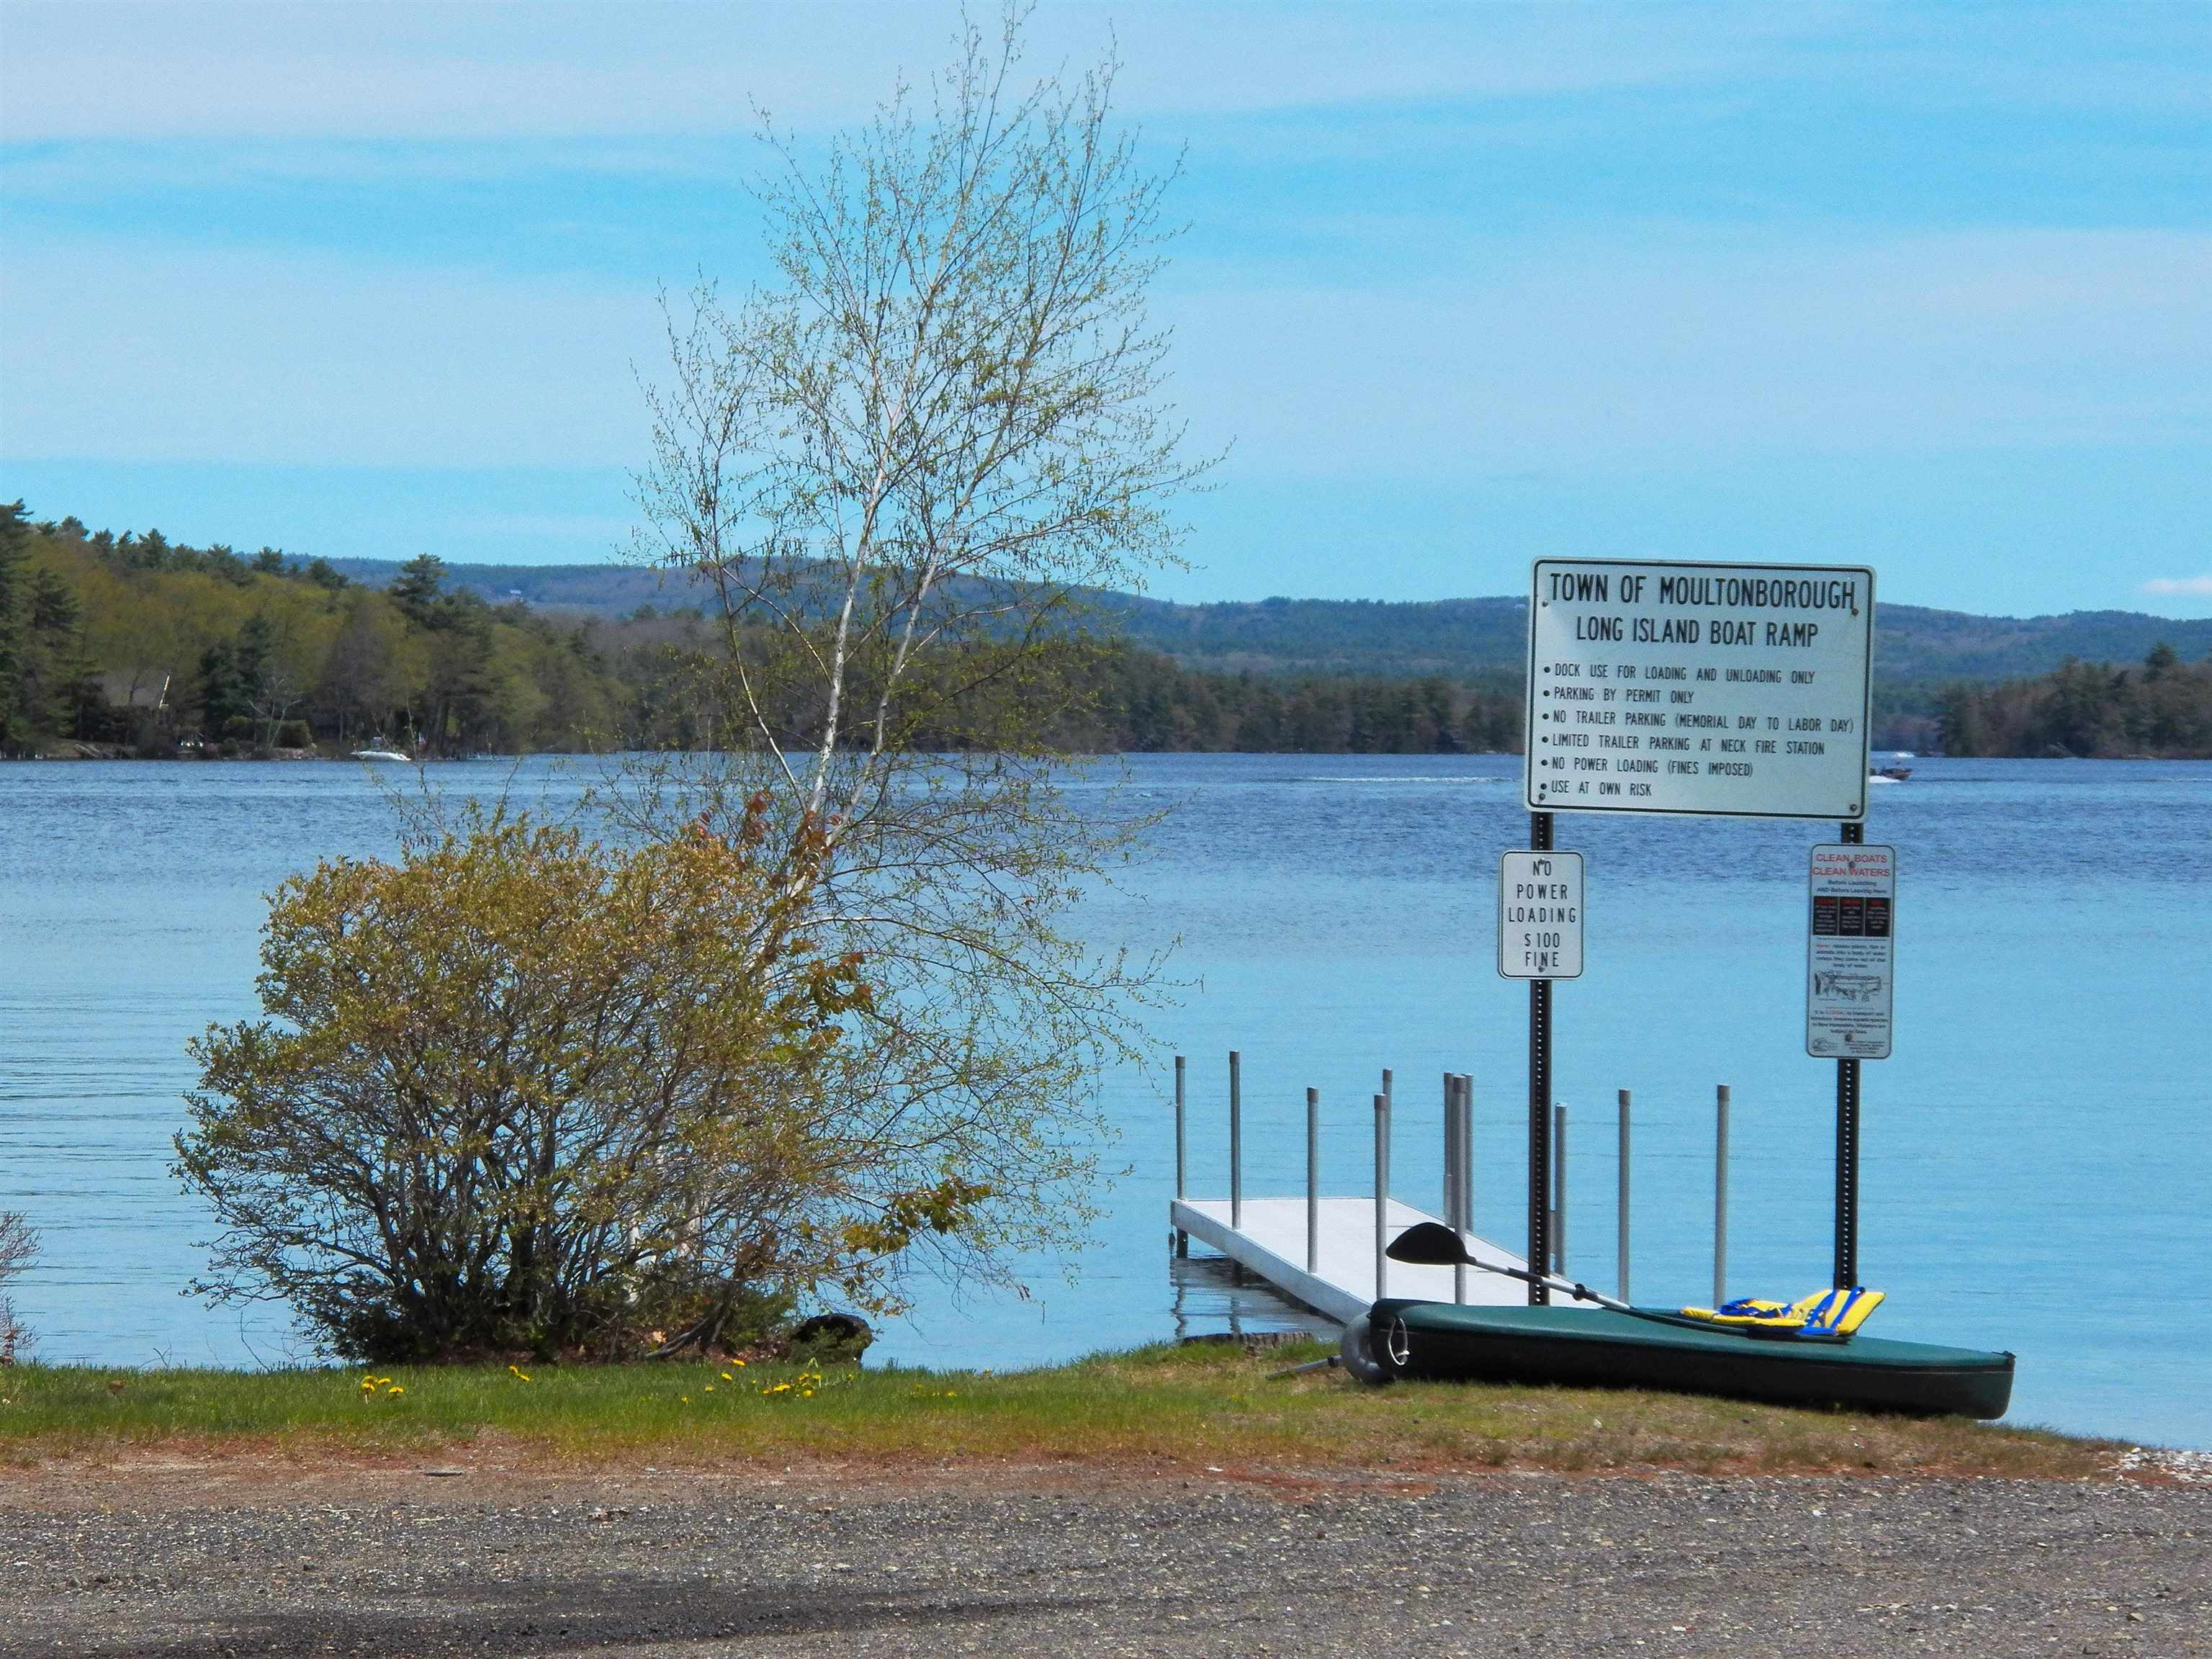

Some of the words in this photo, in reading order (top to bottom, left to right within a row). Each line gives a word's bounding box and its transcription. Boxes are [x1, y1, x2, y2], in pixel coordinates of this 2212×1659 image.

[1550, 573, 1609, 602] TOWN
[1621, 575, 1647, 603] OF
[1660, 576, 1856, 609] MOULTONBOROUGH
[1577, 616, 1624, 642] LONG
[1632, 618, 1700, 644] ISLAND
[1710, 620, 1757, 646] BOAT
[1766, 621, 1819, 647] RAMP
[1555, 663, 1581, 677] DOCK
[1590, 665, 1609, 678] USE
[1617, 665, 1636, 679] FOR
[1645, 666, 1687, 680] LOADING
[1696, 668, 1717, 681] AND
[1726, 669, 1782, 683] UNLOADING
[1791, 671, 1815, 684] ONLY
[1554, 686, 1594, 701] PARKING
[1604, 688, 1617, 701] BY
[1626, 688, 1661, 703] PERMIT
[1671, 690, 1694, 703] ONLY
[1553, 710, 1567, 724] NO
[1575, 711, 1616, 725] TRAILER
[1624, 711, 1666, 727] PARKING
[1676, 714, 1730, 729] (MEMORIAL
[1738, 716, 1758, 729] DAY
[1767, 717, 1779, 730] TO
[1789, 717, 1821, 732] LABOR
[1830, 719, 1854, 734] DAY)
[1552, 734, 1589, 747] LIMITED
[1599, 734, 1639, 749] TRAILER
[1650, 737, 1690, 751] PARKING
[1701, 739, 1712, 752] AT
[1721, 739, 1746, 752] NECK
[1755, 739, 1777, 754] FIRE
[1786, 741, 1825, 755] STATION
[1552, 757, 1565, 770] NO
[1574, 757, 1608, 772] POWER
[1617, 758, 1658, 773] LOADING
[1668, 759, 1699, 775] (FINES
[1709, 763, 1753, 778] IMPOSED)
[1551, 781, 1570, 793] USE
[1578, 781, 1590, 794] AT
[1599, 782, 1621, 796] OWN
[1630, 783, 1652, 796] RISK
[1816, 853, 1850, 862] CLEAN
[1532, 860, 1552, 876] NO
[1813, 867, 1846, 876] CLEAN
[1517, 884, 1568, 899] POWER
[1509, 907, 1576, 923] LOADING
[1525, 951, 1559, 967] FINE
